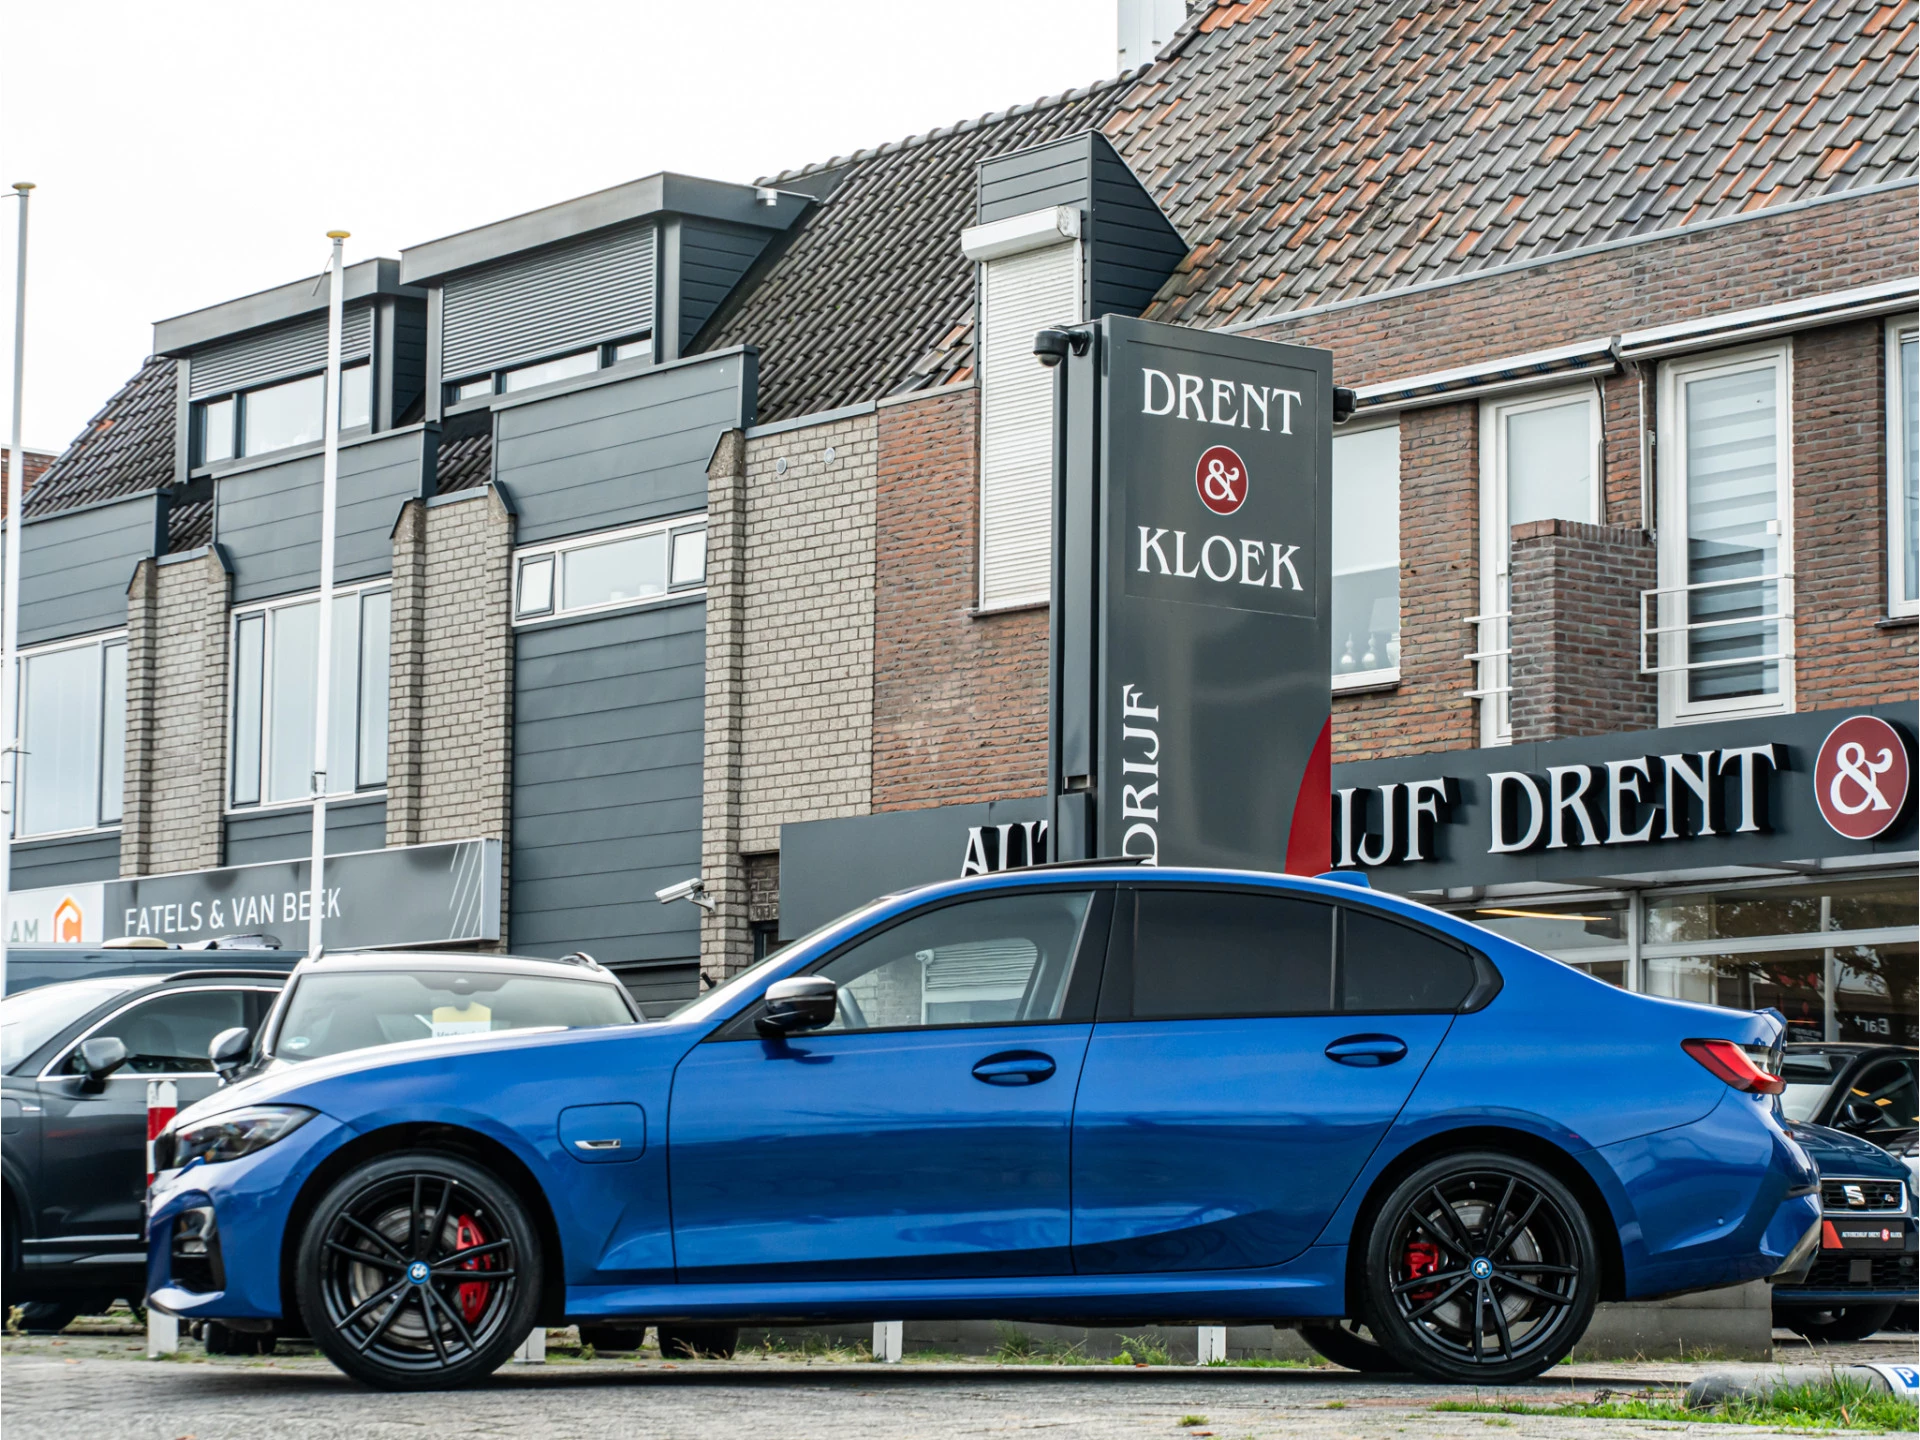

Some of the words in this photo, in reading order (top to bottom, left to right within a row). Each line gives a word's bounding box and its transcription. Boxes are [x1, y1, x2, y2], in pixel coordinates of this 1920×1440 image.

[1141, 368, 1302, 434] DRENT
[1204, 459, 1240, 502] &
[1137, 526, 1304, 591] KLOEK
[1122, 683, 1160, 867] DRIJF
[1331, 776, 1448, 867] IJF
[1487, 743, 1778, 853] DRENT
[1830, 742, 1893, 815] &
[125, 901, 203, 936] FATELS
[209, 899, 225, 929] &
[232, 894, 275, 927] VAN
